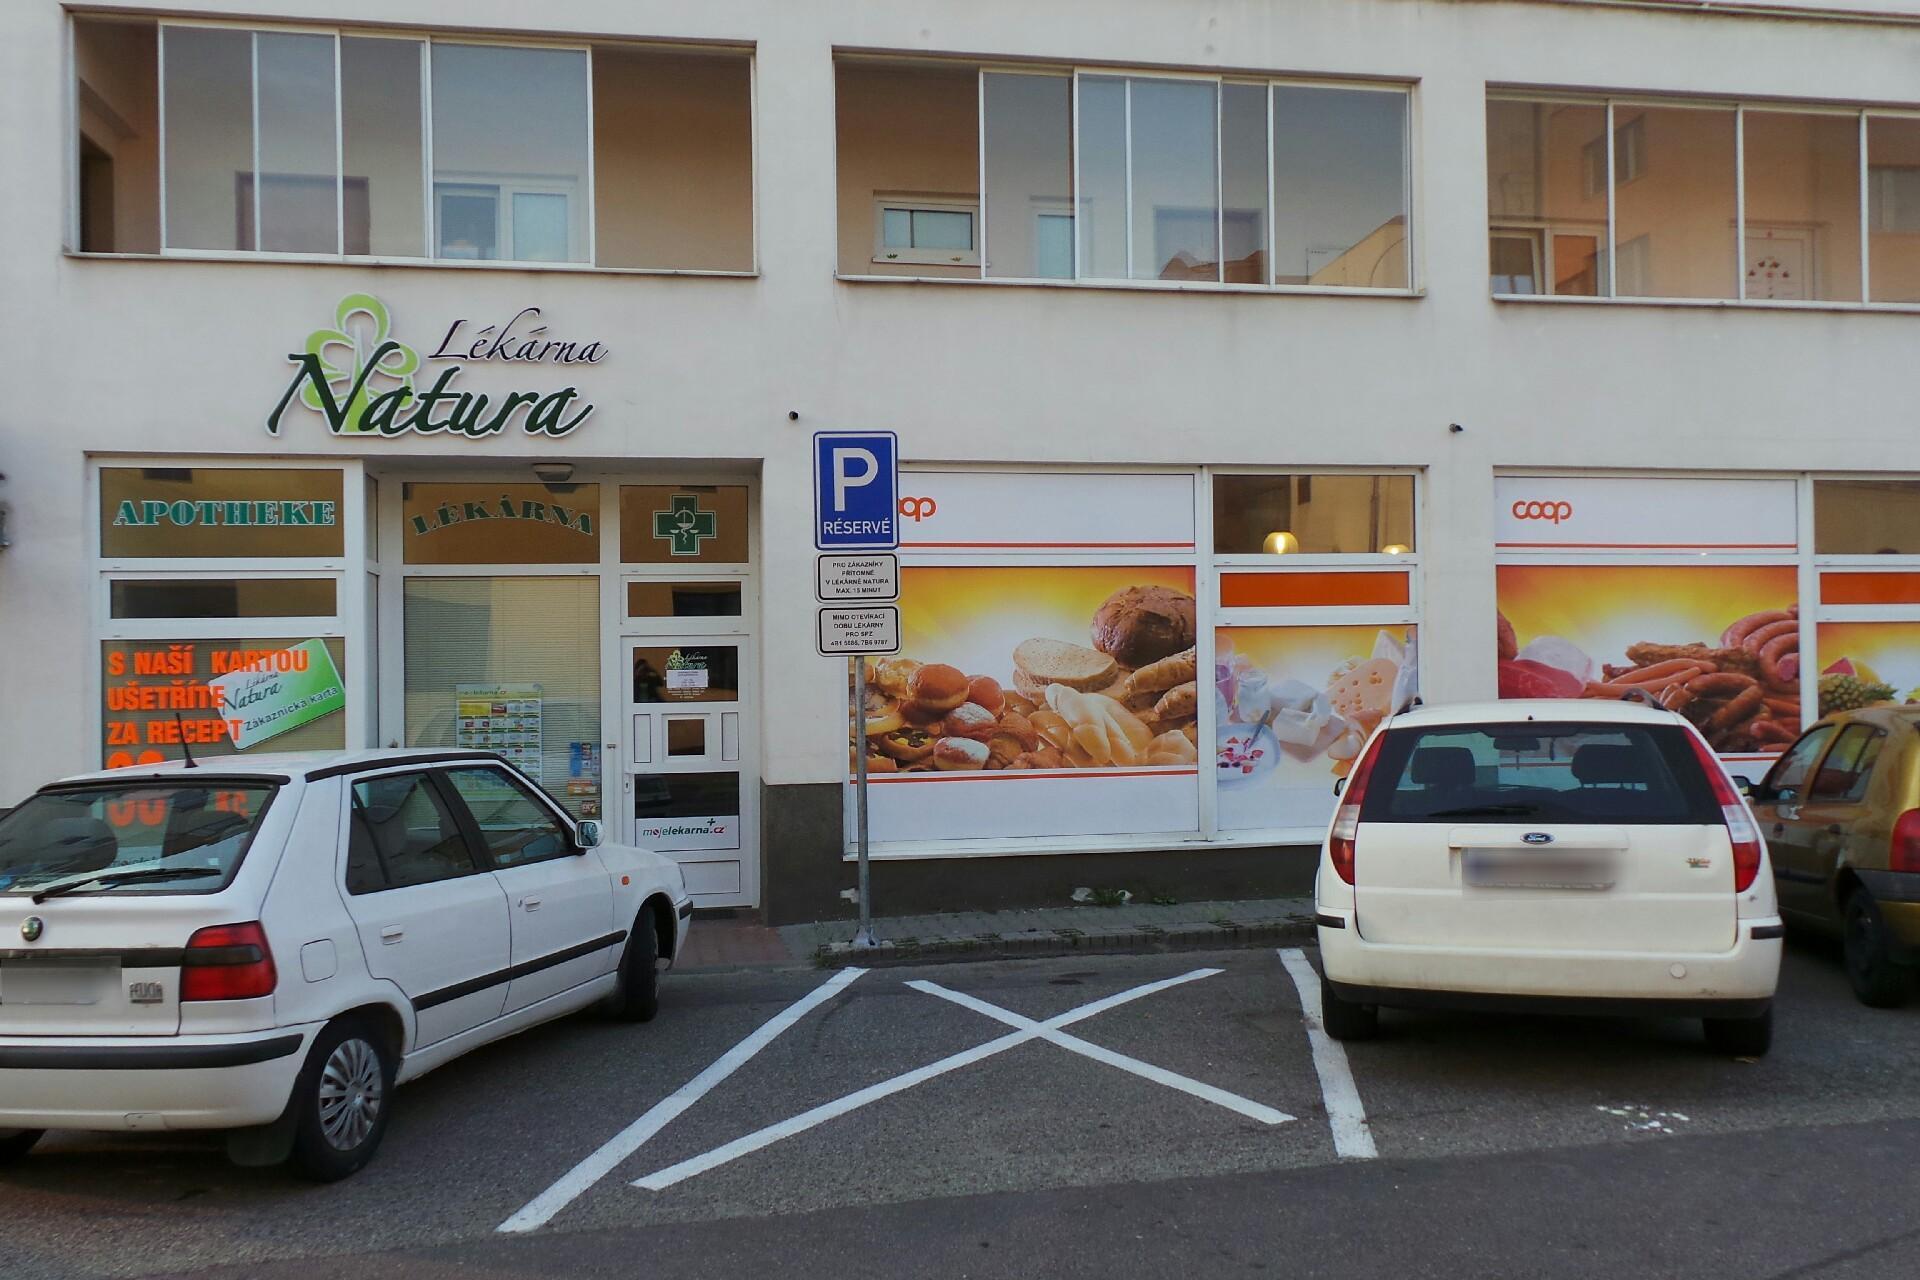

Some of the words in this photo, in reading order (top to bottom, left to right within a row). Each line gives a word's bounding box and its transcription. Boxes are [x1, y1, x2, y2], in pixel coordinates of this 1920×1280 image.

[428, 307, 607, 363] Lékárna
[267, 341, 594, 436] Natura
[833, 447, 879, 511] P
[112, 500, 335, 526] APOTHEKE
[409, 495, 593, 536] LÉKÁRNA
[823, 518, 891, 535] RÉSERVÉ
[1512, 500, 1572, 524] coop
[108, 652, 126, 675] S
[134, 645, 193, 674] NAŠÍ
[211, 650, 308, 674] KARTOU
[107, 681, 225, 711] UŠETŘÍTE
[222, 682, 283, 715] Natura
[309, 686, 339, 704] karta
[107, 722, 139, 745] ZA
[147, 720, 243, 744] RECEPT
